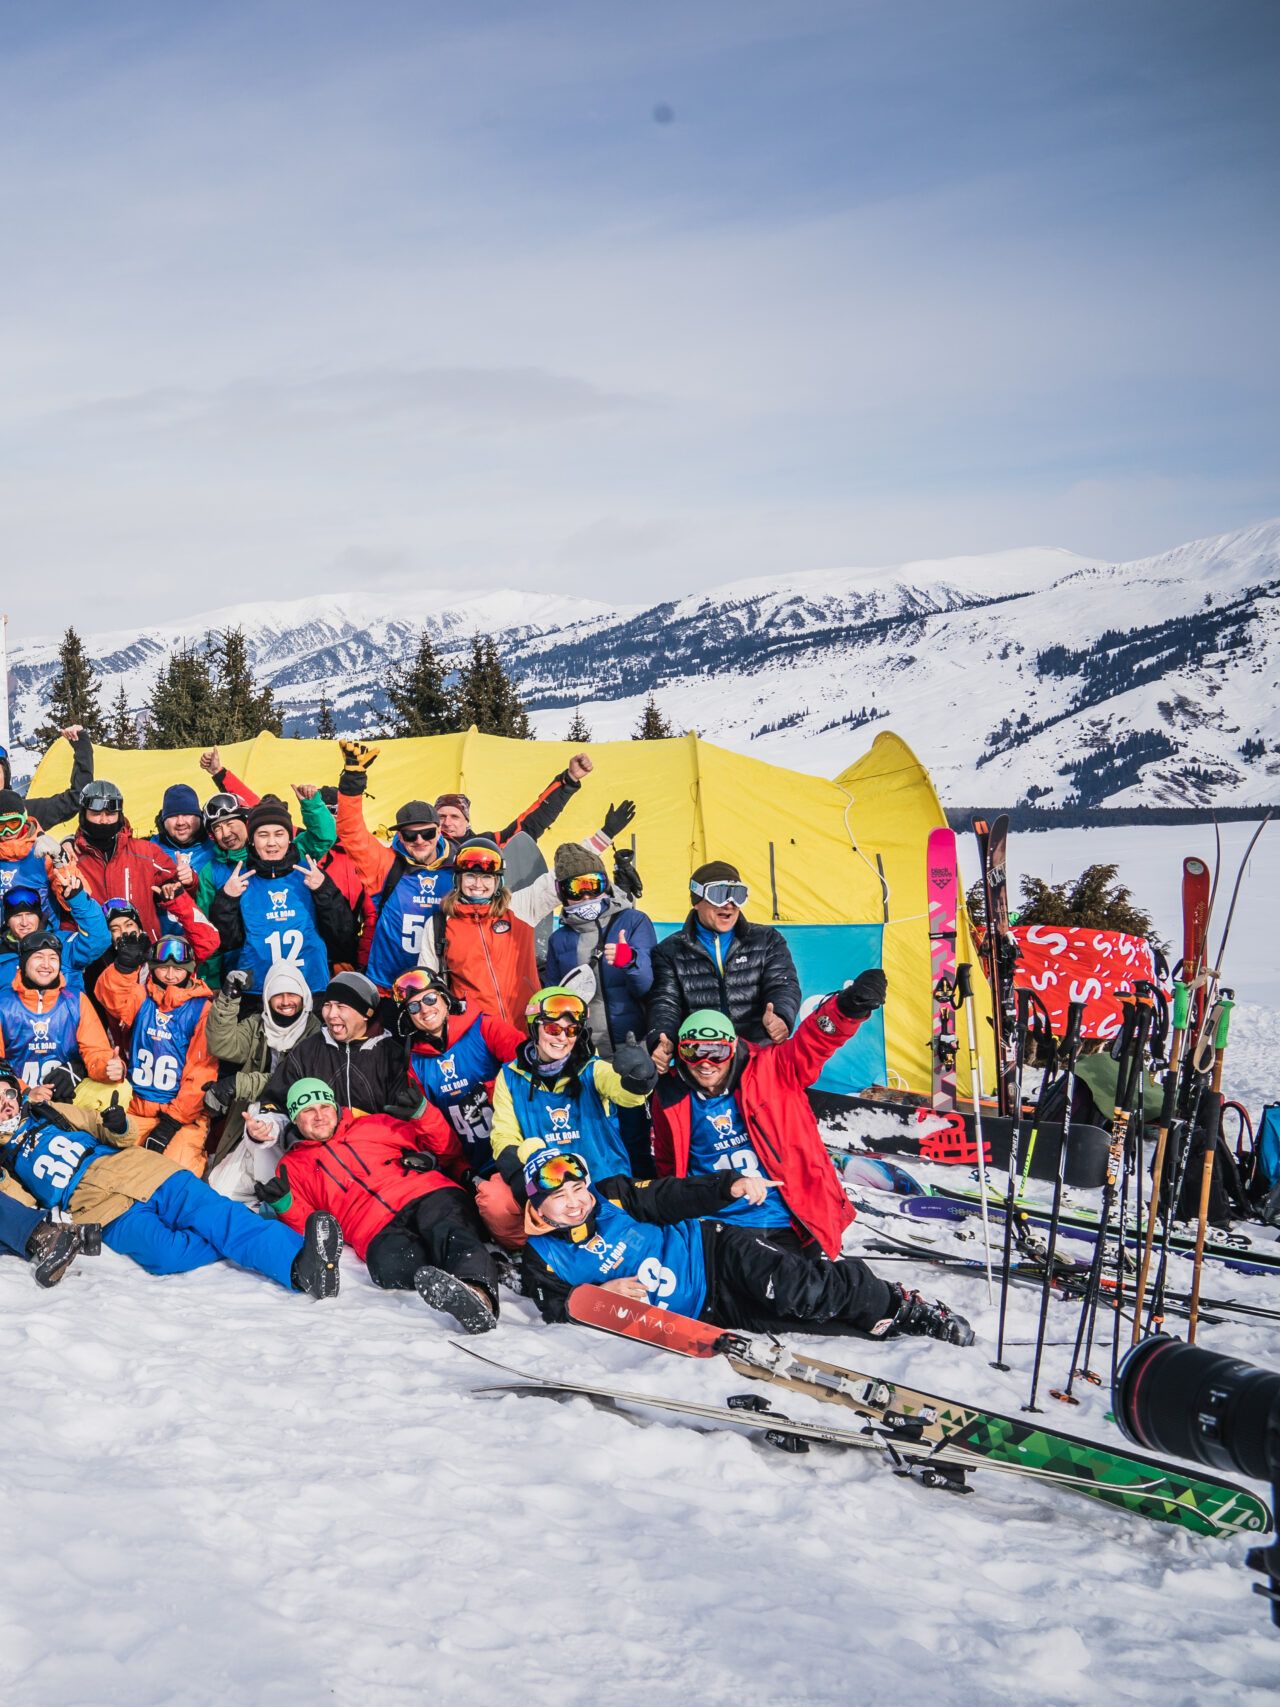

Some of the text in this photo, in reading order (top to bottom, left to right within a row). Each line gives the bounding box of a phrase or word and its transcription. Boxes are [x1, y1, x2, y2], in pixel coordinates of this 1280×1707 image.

[412, 896, 426, 904] SILK
[266, 909, 296, 920] SILK ROAD
[264, 929, 305, 967] 12
[41, 1042, 57, 1050] ROAD
[132, 1048, 179, 1091] 36
[440, 1078, 469, 1093] SILK ROAD
[544, 1131, 562, 1142] SILK
[713, 1141, 731, 1151] SILK
[32, 1135, 86, 1189] 38
[599, 1241, 627, 1275] SILK ROAD
